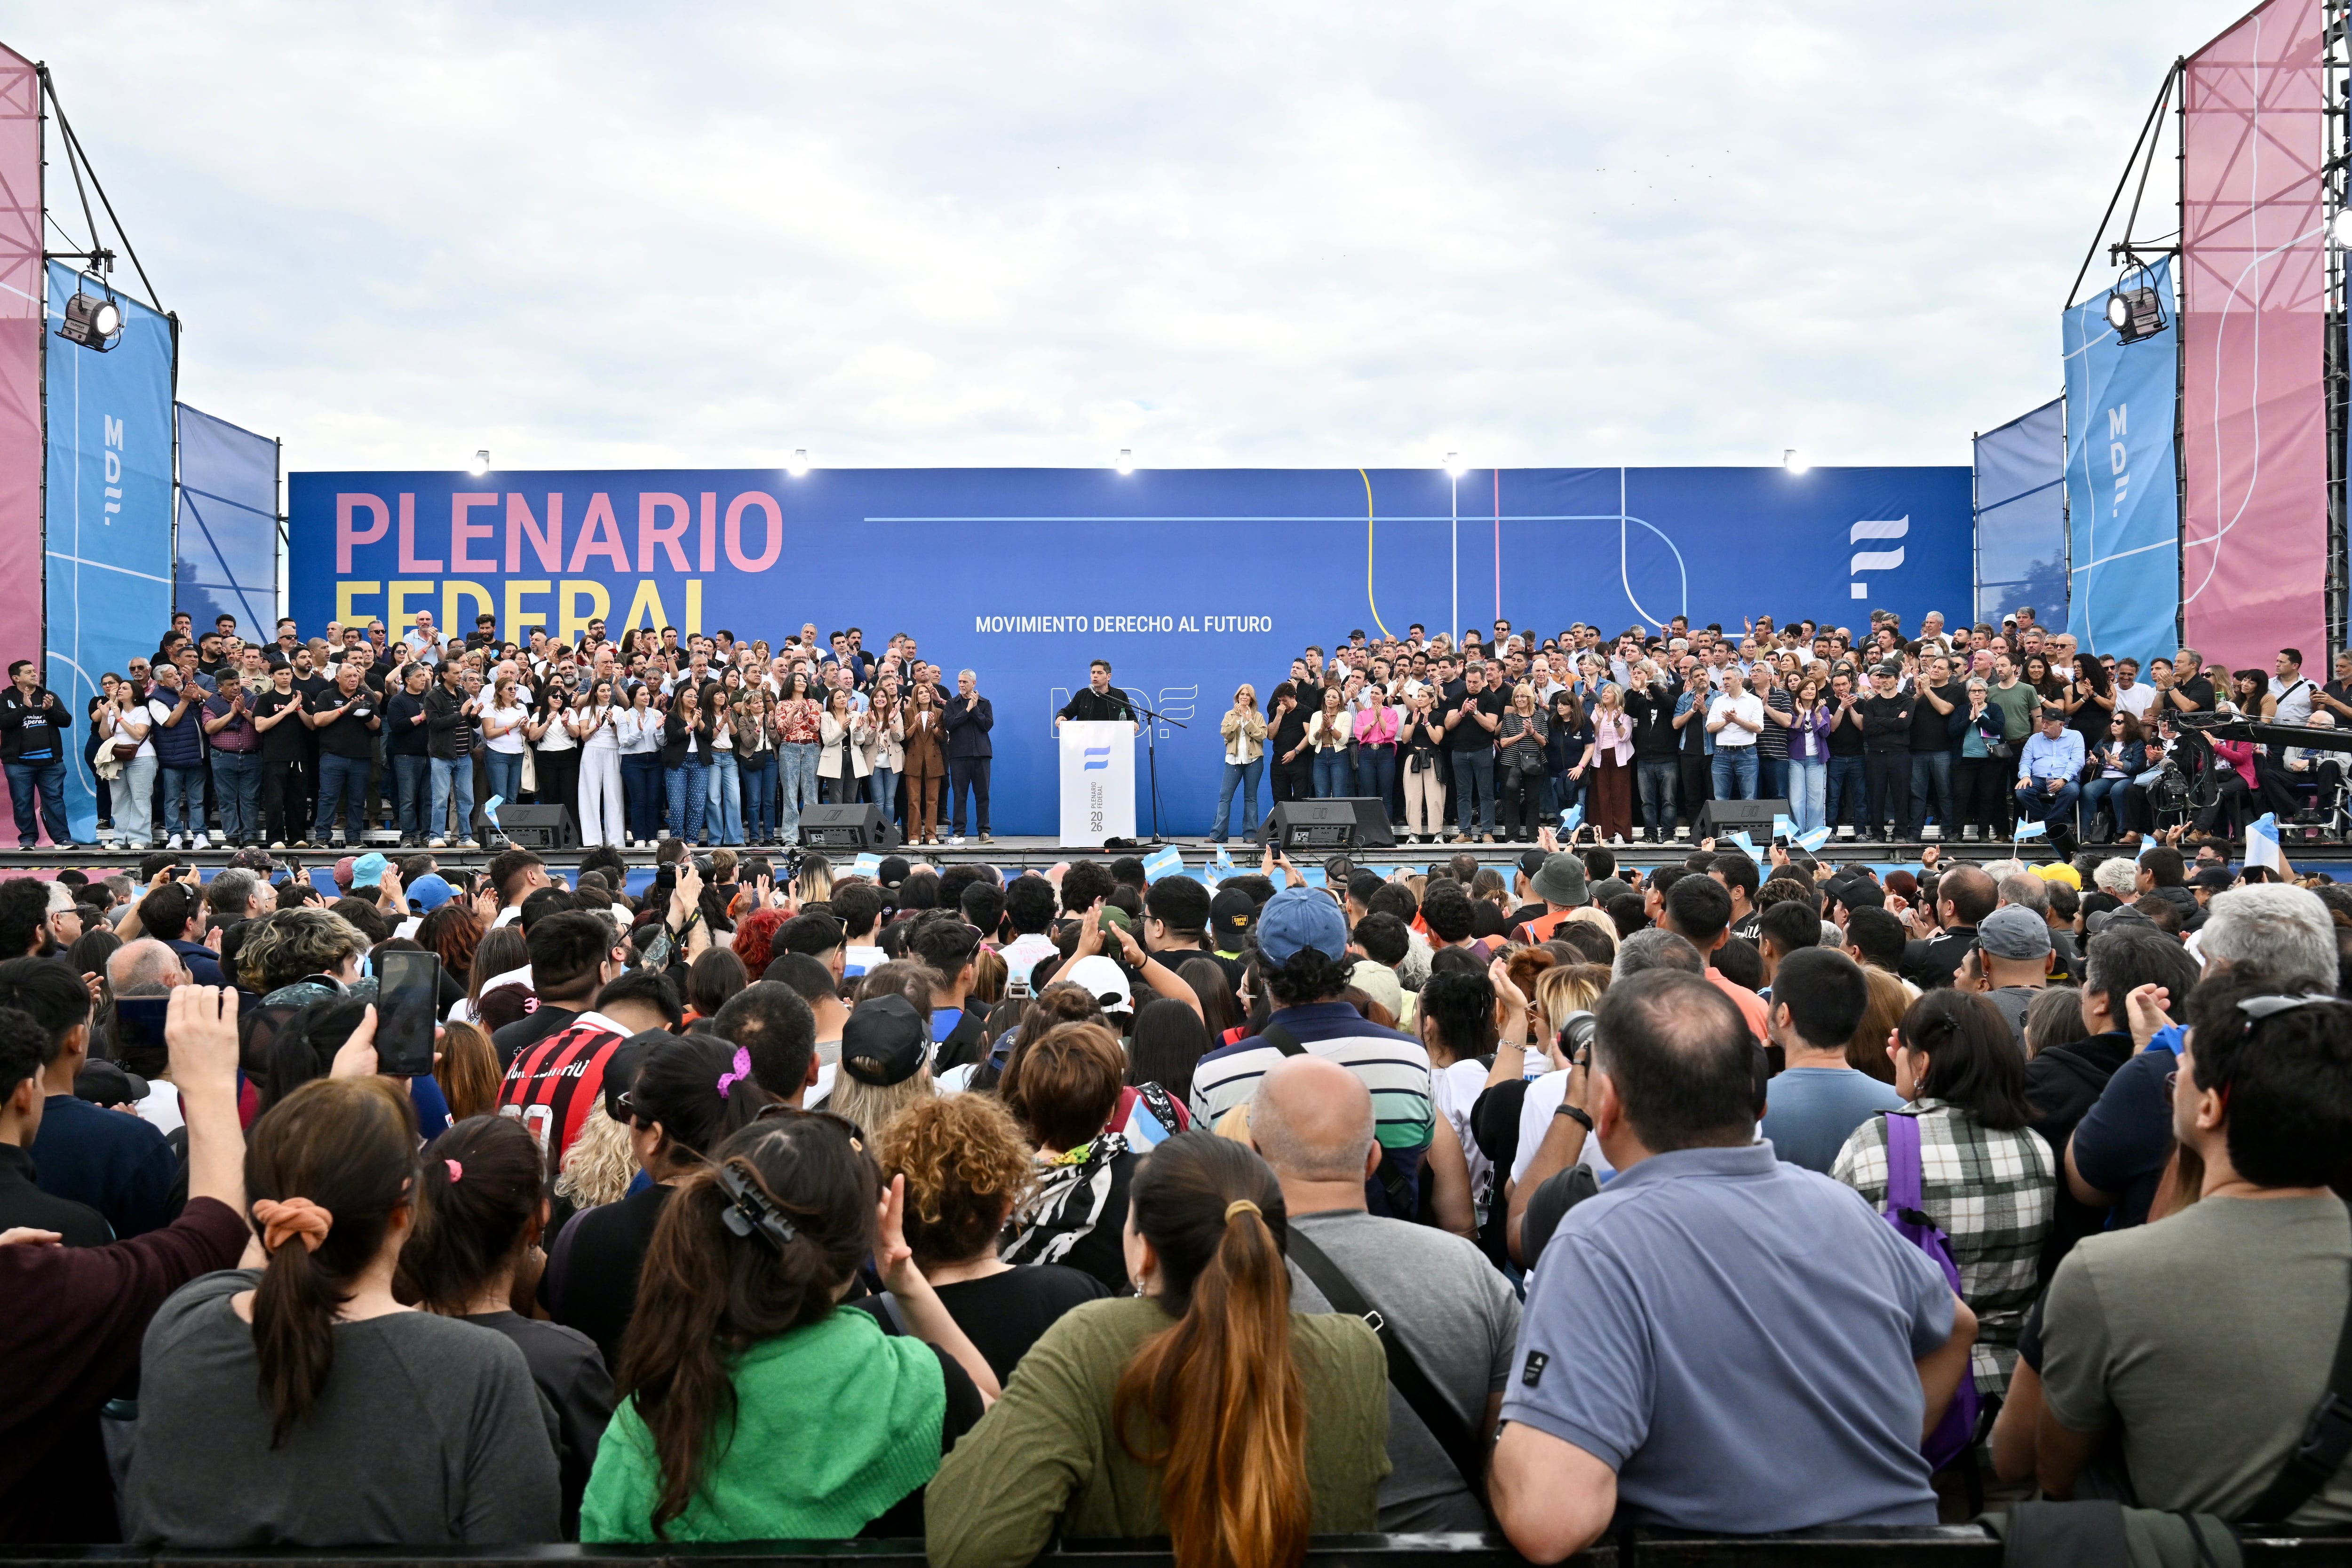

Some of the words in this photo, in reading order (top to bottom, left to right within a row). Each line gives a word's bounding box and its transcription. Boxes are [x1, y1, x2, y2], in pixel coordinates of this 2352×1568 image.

[336, 491, 783, 573] PLENARIO
[976, 616, 1088, 632] MOVIMIENTO
[1094, 616, 1173, 632] DERECHO
[1178, 616, 1200, 632] AL
[1205, 616, 1272, 632] FUTURO
[1091, 812, 1103, 821] 20
[1091, 822, 1103, 832] 26
